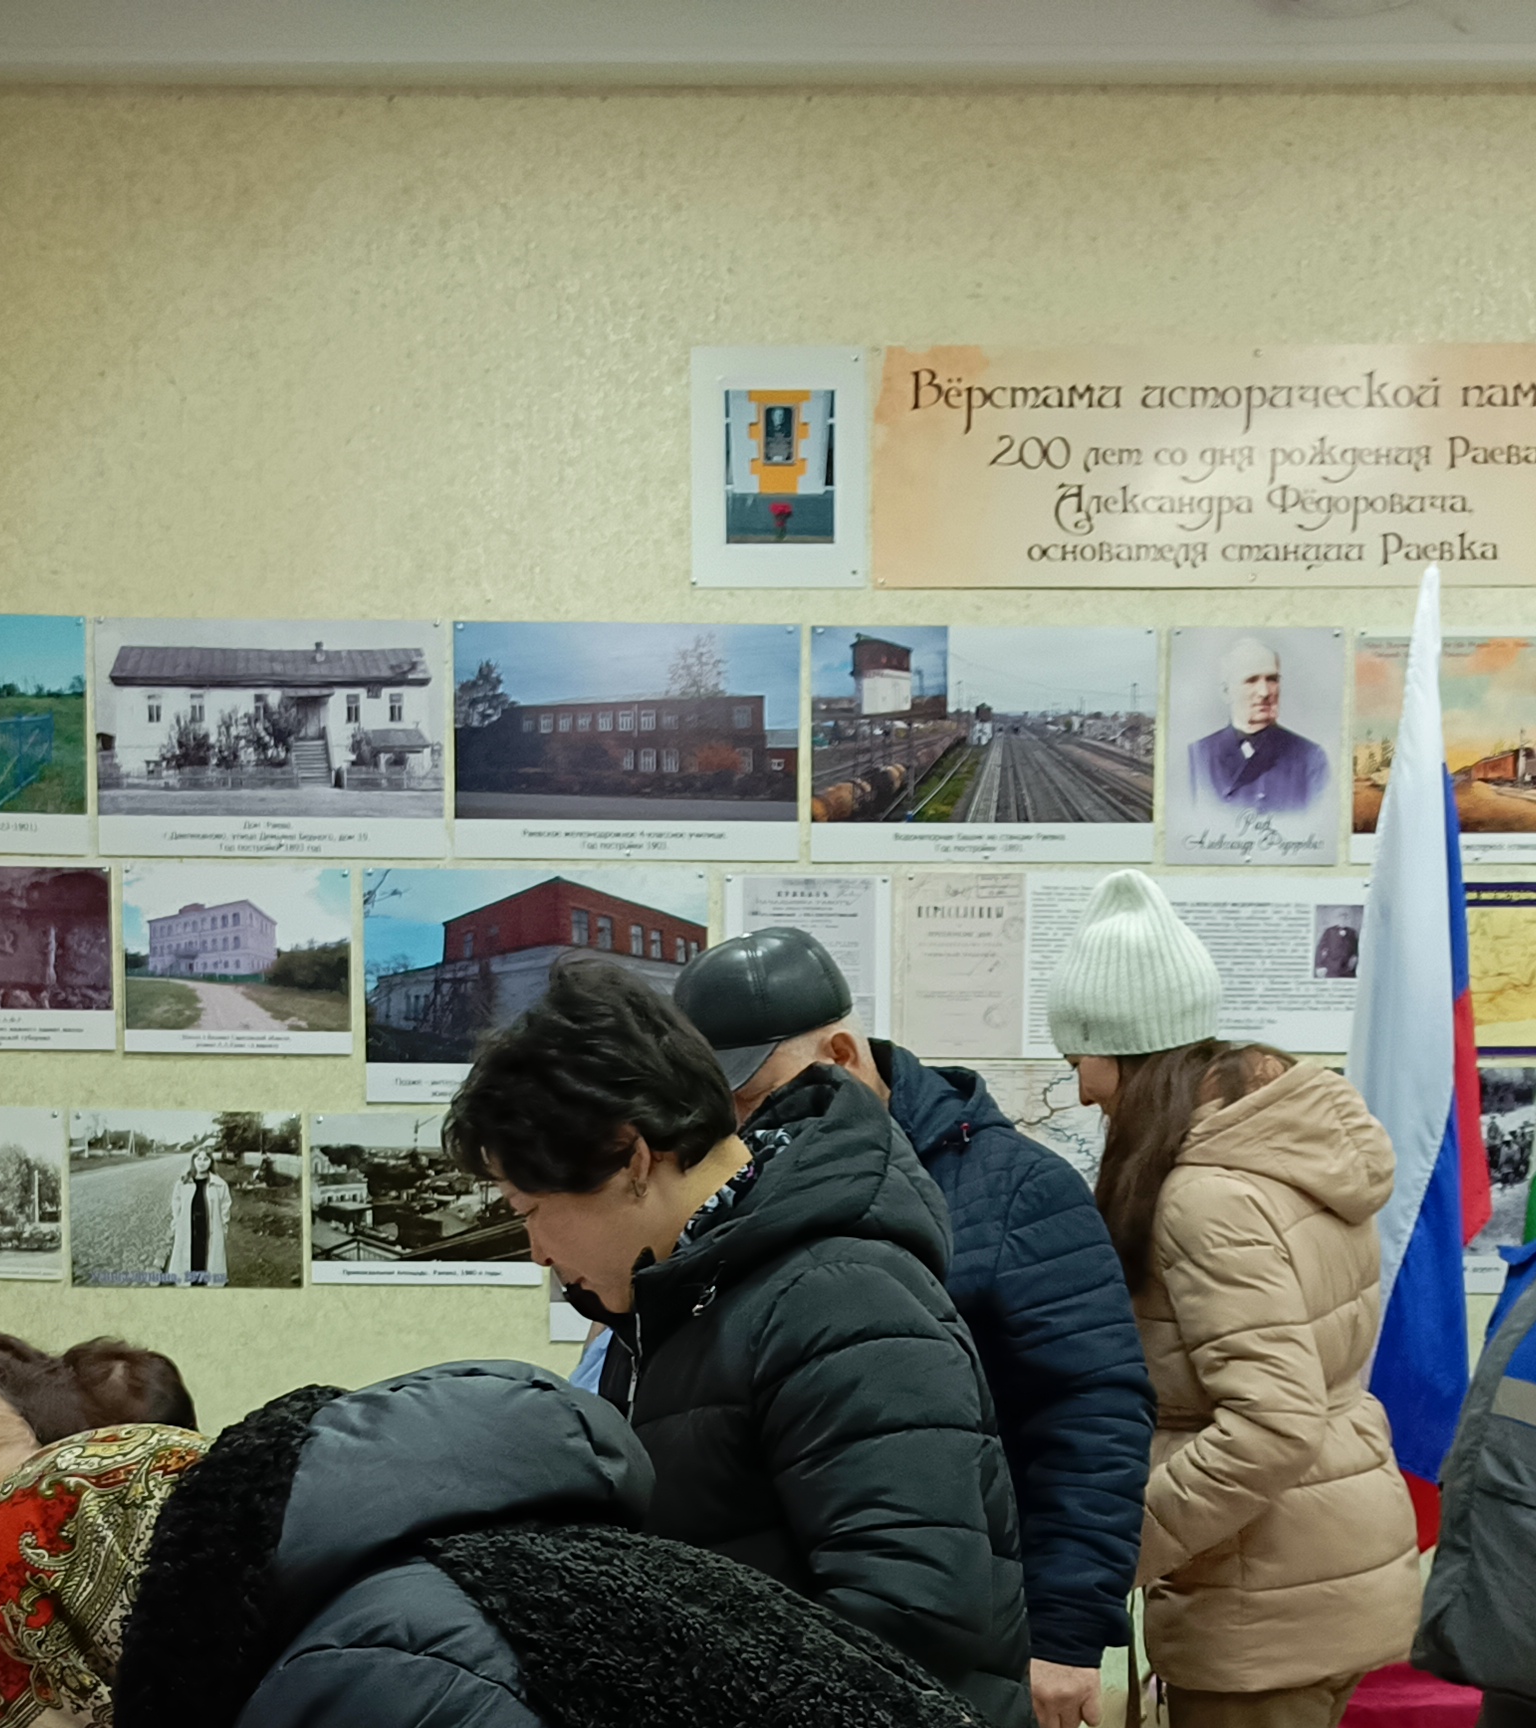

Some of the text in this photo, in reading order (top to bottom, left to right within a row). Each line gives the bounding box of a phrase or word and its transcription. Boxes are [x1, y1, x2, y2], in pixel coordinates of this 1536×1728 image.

[910, 368, 1124, 435] Вёрстами
[1141, 369, 1443, 436] исторической
[988, 434, 1071, 470] 200
[1083, 446, 1144, 473] лет
[1154, 447, 1188, 467] со
[1180, 444, 1255, 484] дня
[1267, 435, 1432, 485] рождения
[1054, 483, 1254, 536] Александра
[1027, 531, 1500, 571] основателя станции Раевка
